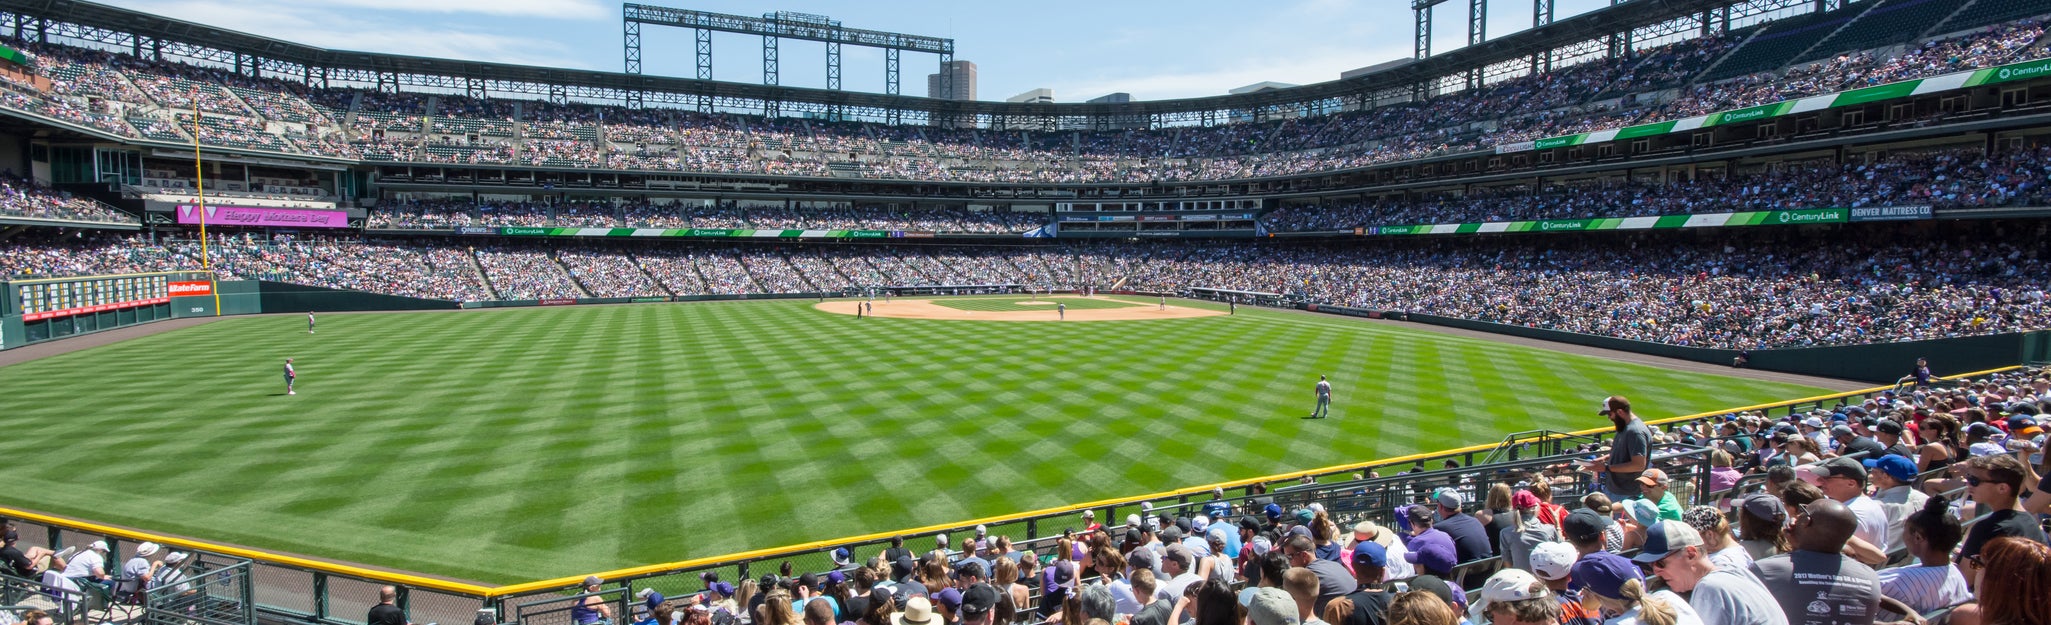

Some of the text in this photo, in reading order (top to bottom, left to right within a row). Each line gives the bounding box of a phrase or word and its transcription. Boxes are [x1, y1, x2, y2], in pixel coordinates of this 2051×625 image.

[1732, 109, 1764, 119] CenturyLink
[1791, 211, 1839, 221] CenturyLink
[1851, 208, 1880, 217] DENVER
[1881, 206, 1918, 216] MATTRESS
[224, 210, 260, 222] Happy
[310, 214, 329, 224] Day
